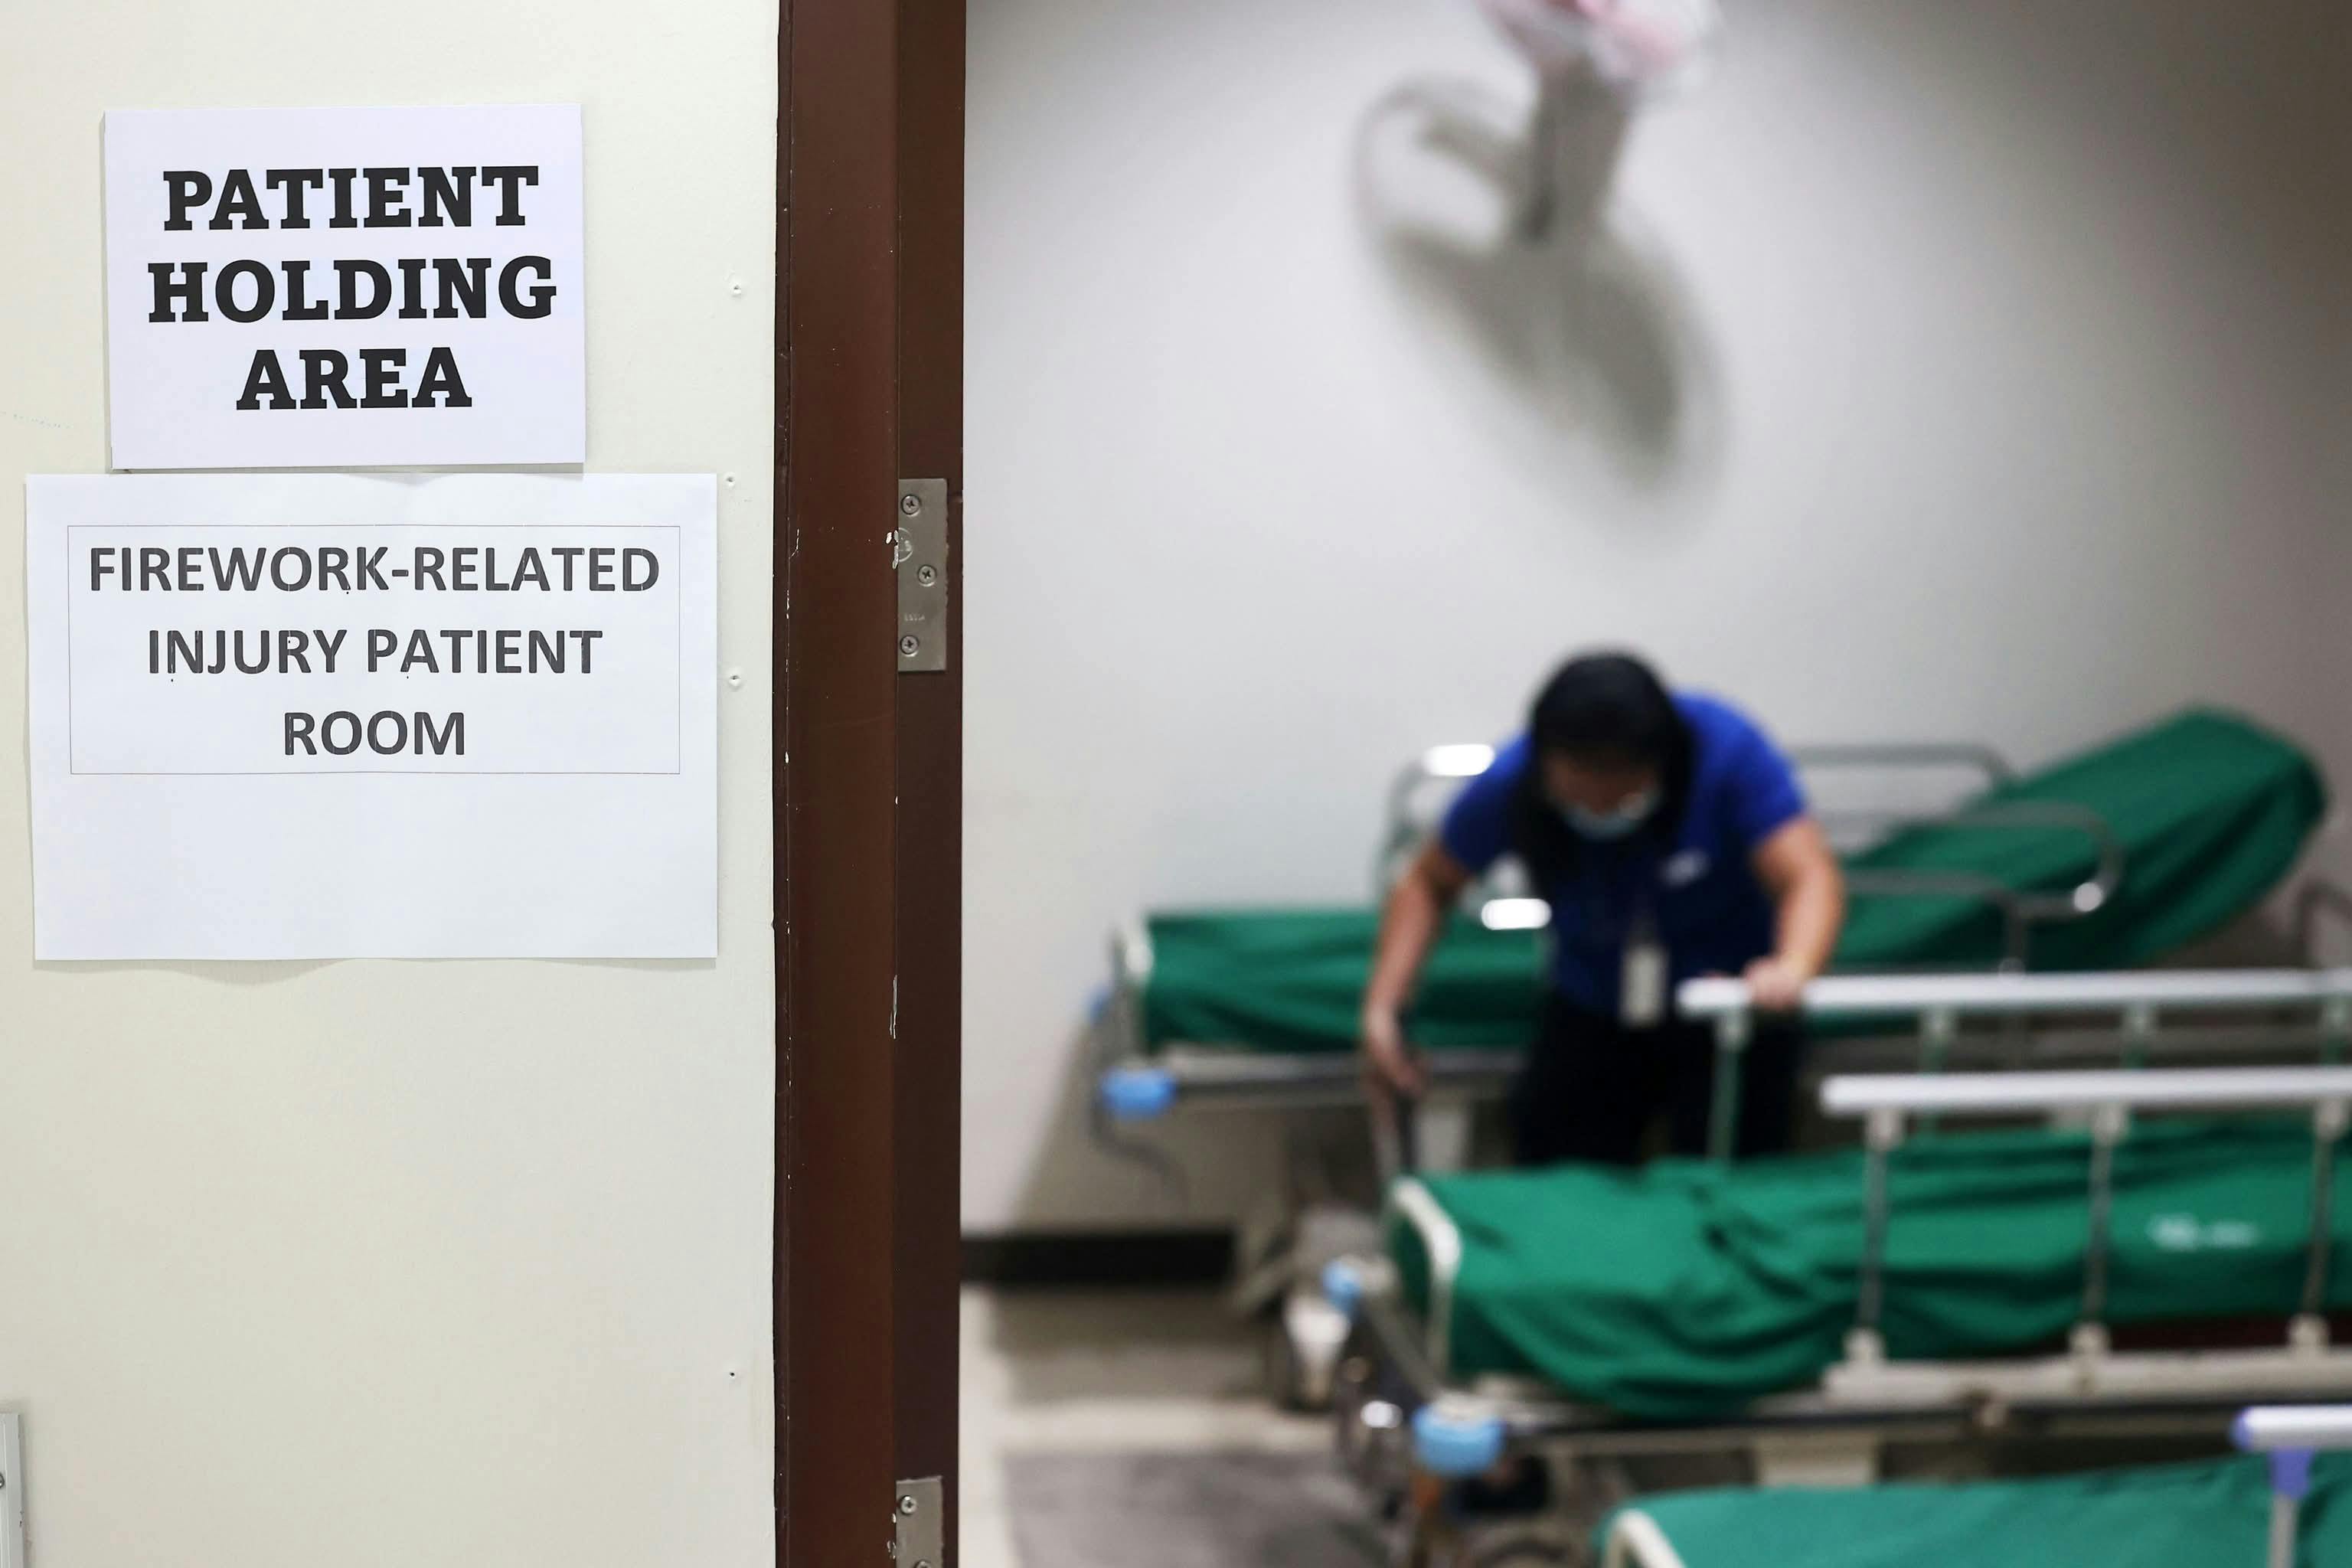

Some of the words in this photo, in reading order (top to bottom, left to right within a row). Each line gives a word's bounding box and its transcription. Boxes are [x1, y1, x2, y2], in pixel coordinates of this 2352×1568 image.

[163, 166, 539, 230] PATIENT
[149, 256, 557, 322] HOLDING
[237, 348, 472, 410] AREA
[90, 547, 659, 592] FIREWORK-RELATED
[149, 629, 348, 674] INJURY
[368, 629, 603, 674] PATIENT
[284, 710, 465, 756] ROOM
